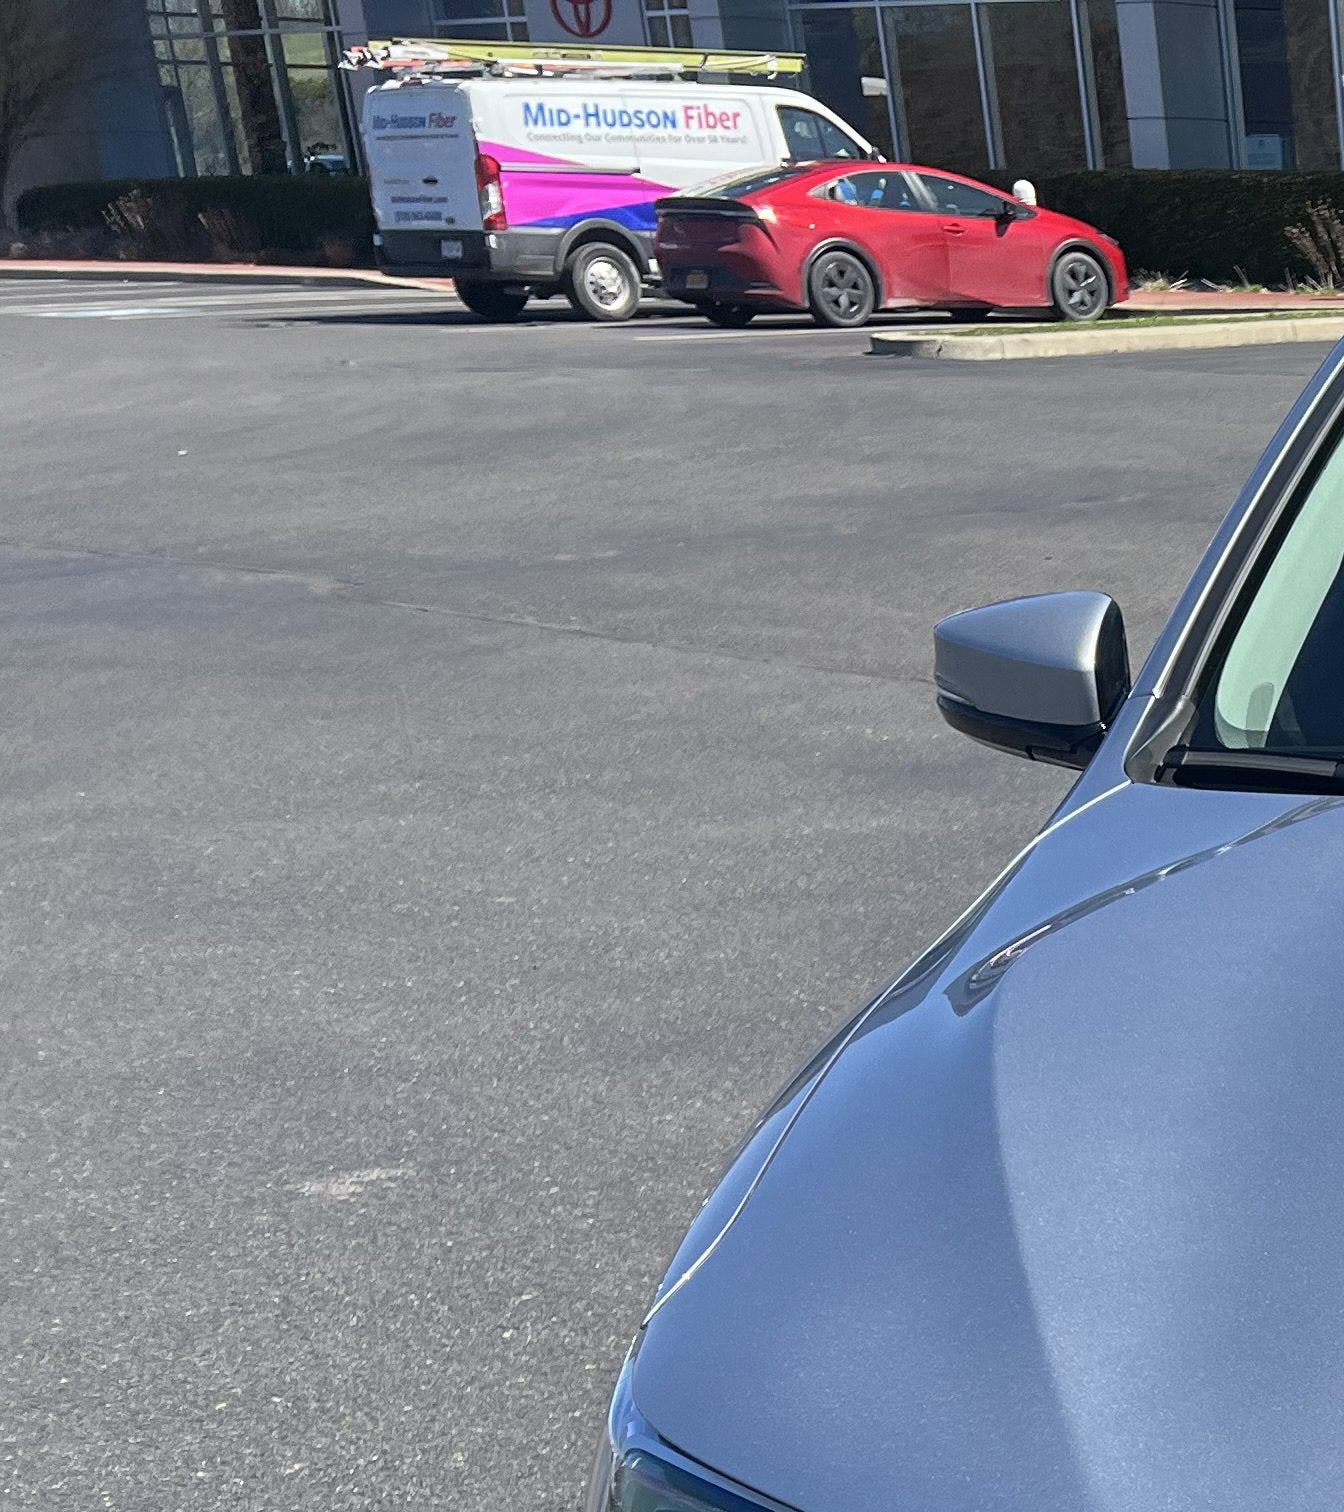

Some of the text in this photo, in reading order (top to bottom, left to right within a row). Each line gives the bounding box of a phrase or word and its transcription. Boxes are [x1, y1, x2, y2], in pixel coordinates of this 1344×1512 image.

[522, 101, 741, 130] MID-HUDSON Fiber
[526, 131, 583, 144] Connecting
[584, 132, 601, 142] Our
[604, 132, 665, 143] Communities
